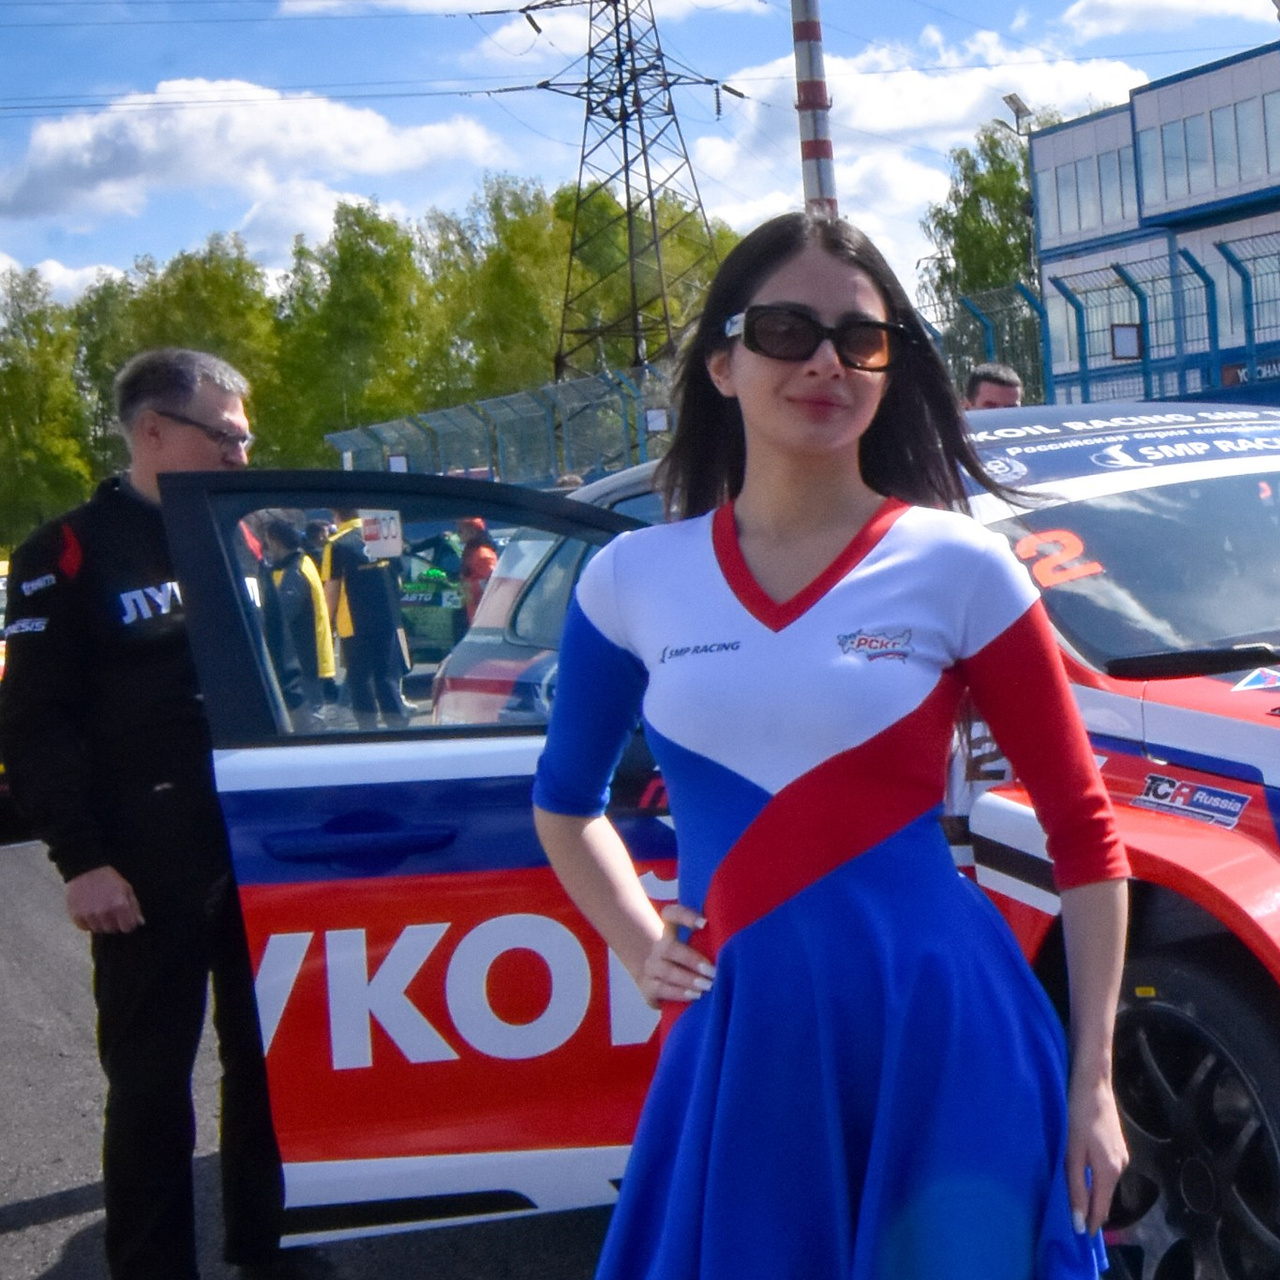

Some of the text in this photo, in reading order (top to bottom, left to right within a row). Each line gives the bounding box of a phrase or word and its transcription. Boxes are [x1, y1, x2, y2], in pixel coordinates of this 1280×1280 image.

[968, 424, 1061, 444] KOIL
[1062, 413, 1196, 432] RACING
[1006, 434, 1130, 457] Российская
[1133, 427, 1190, 442] серия
[1139, 440, 1210, 461] SMP
[1014, 528, 1104, 589] 2
[119, 581, 184, 625] ЛУ
[668, 641, 741, 660] SMP RACING
[1143, 773, 1243, 813] TCR Russia
